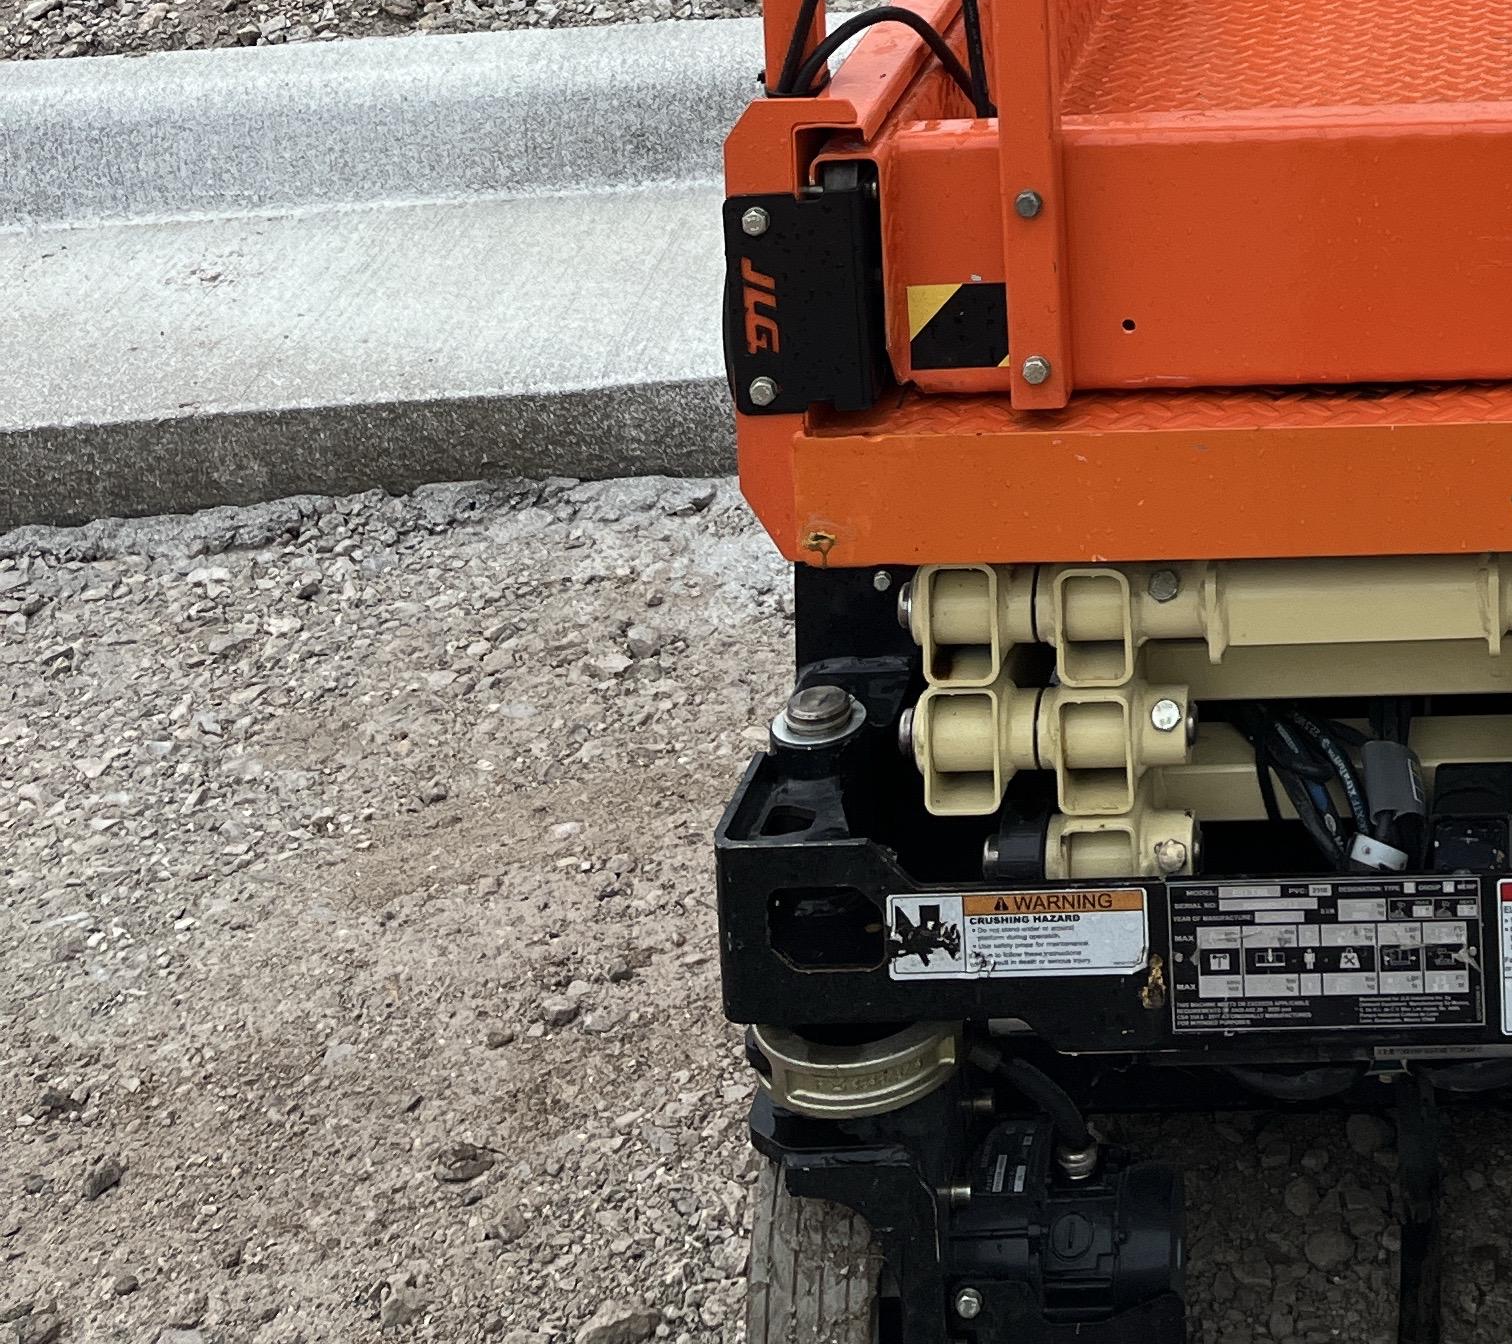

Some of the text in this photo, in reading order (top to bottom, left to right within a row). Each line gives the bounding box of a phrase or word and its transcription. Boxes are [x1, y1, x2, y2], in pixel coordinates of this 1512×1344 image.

[740, 256, 781, 354] JLG
[1014, 892, 1113, 911] WARNING
[969, 914, 1081, 925] CRUSHING HAZARD
